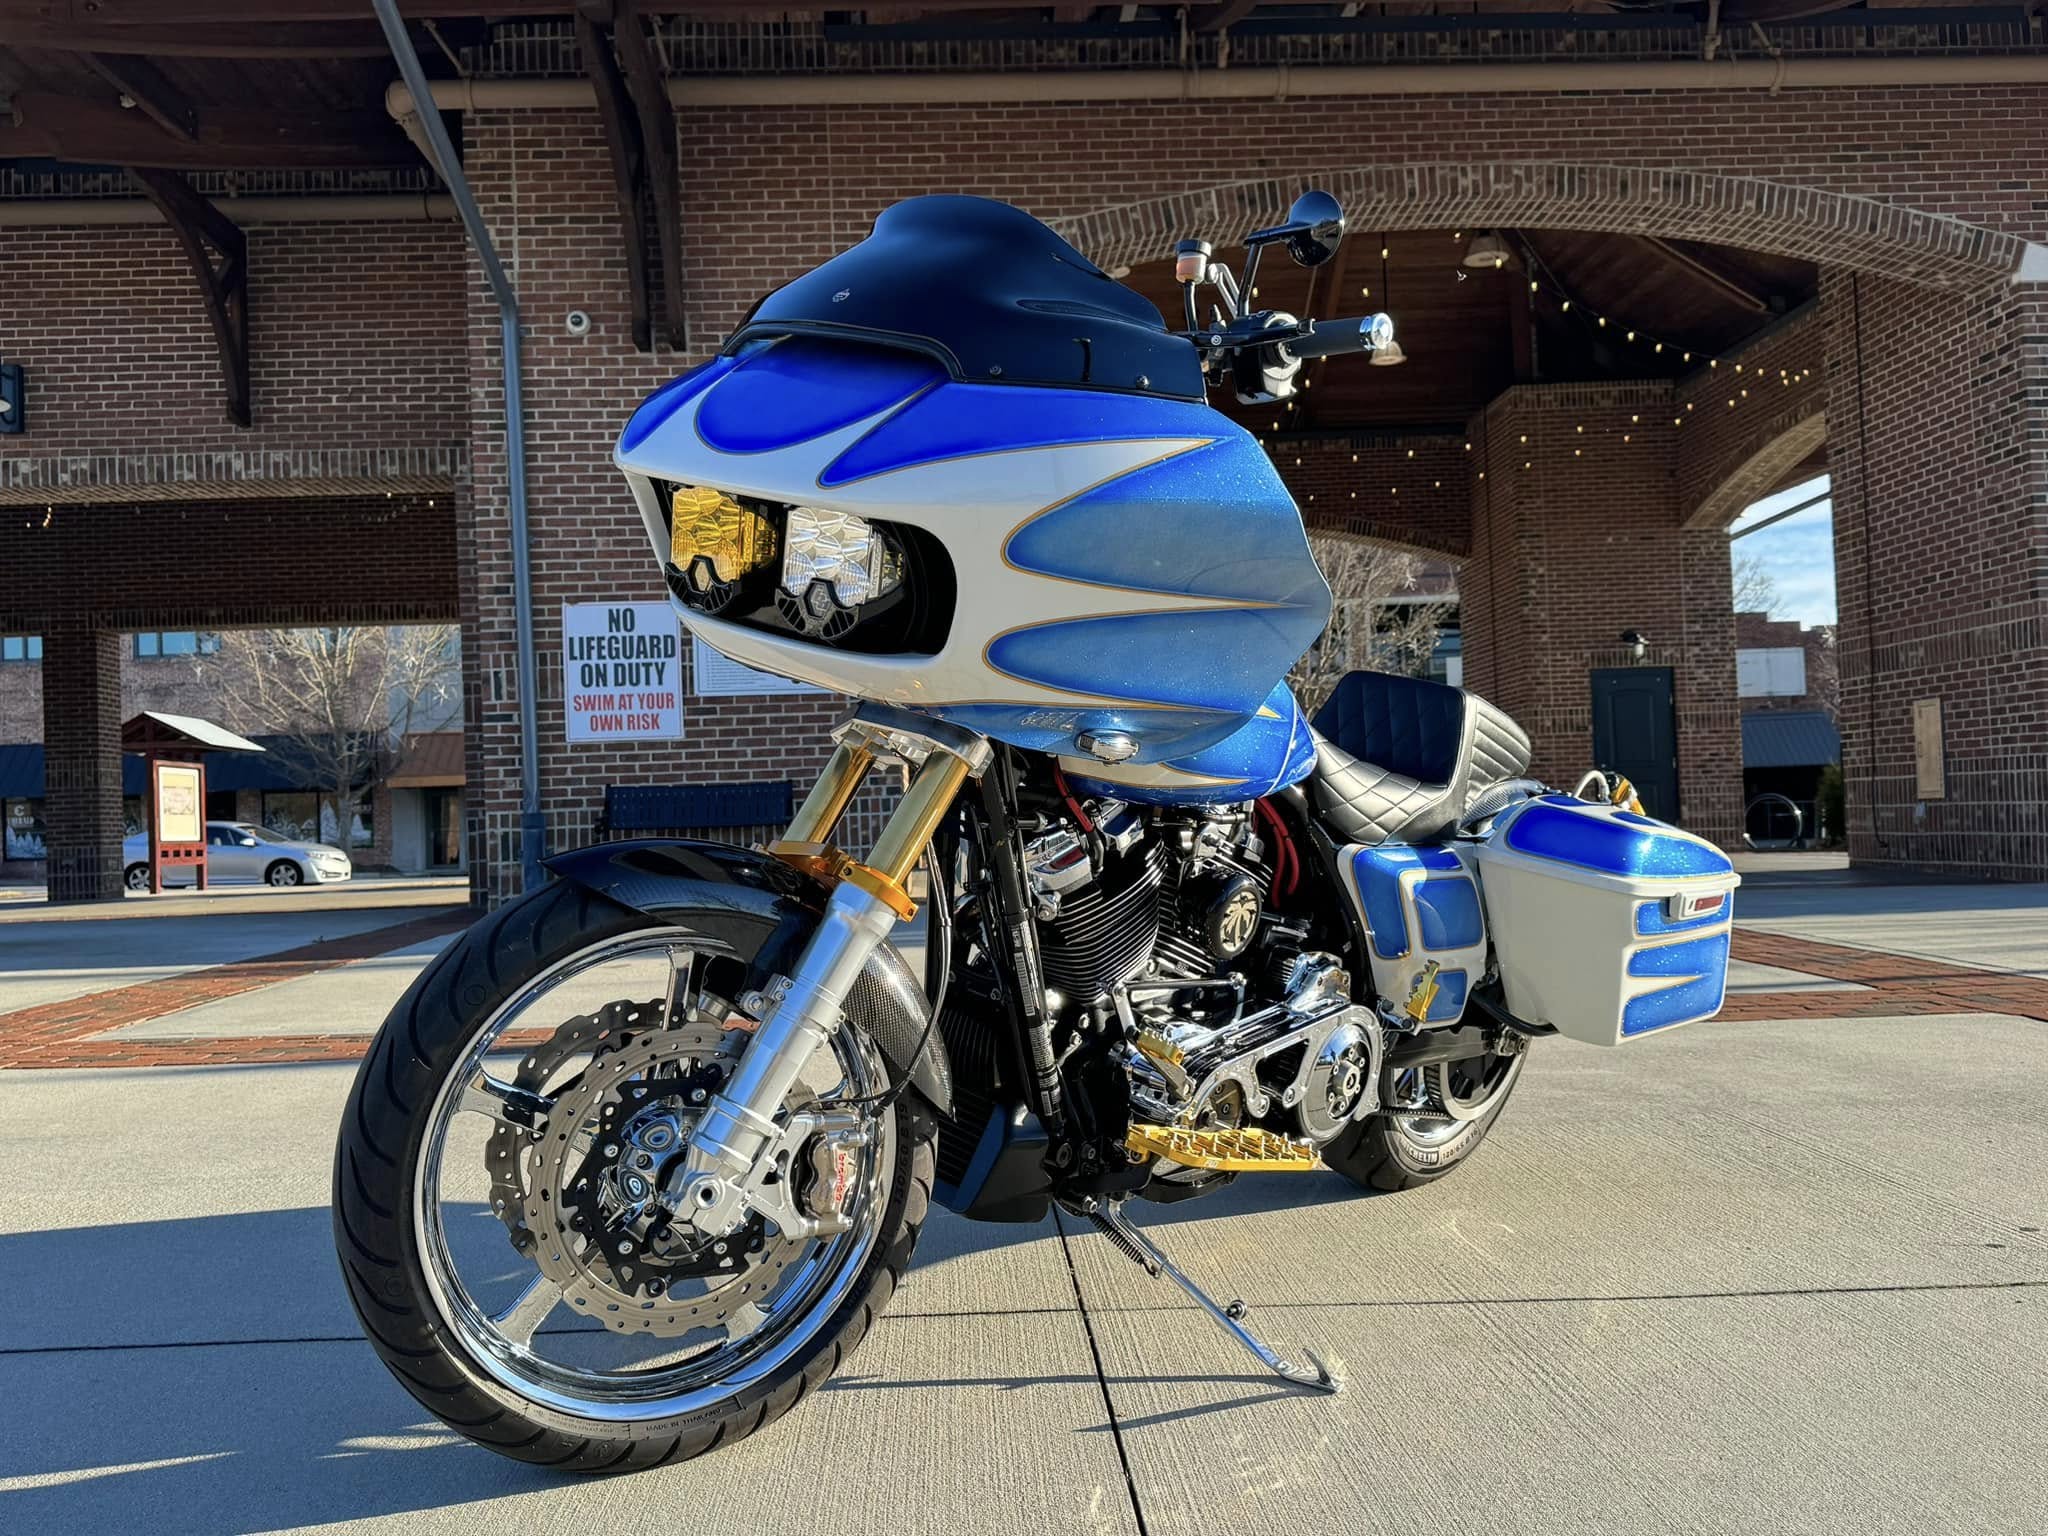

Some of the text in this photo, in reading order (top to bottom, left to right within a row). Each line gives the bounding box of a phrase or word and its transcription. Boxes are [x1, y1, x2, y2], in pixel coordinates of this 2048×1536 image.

[608, 608, 635, 632] NO
[568, 634, 676, 660] LIFEGUARD
[580, 661, 666, 688] ON DUTY
[573, 692, 675, 712] SWIM AT YOUR
[590, 713, 660, 732] OWN RISK
